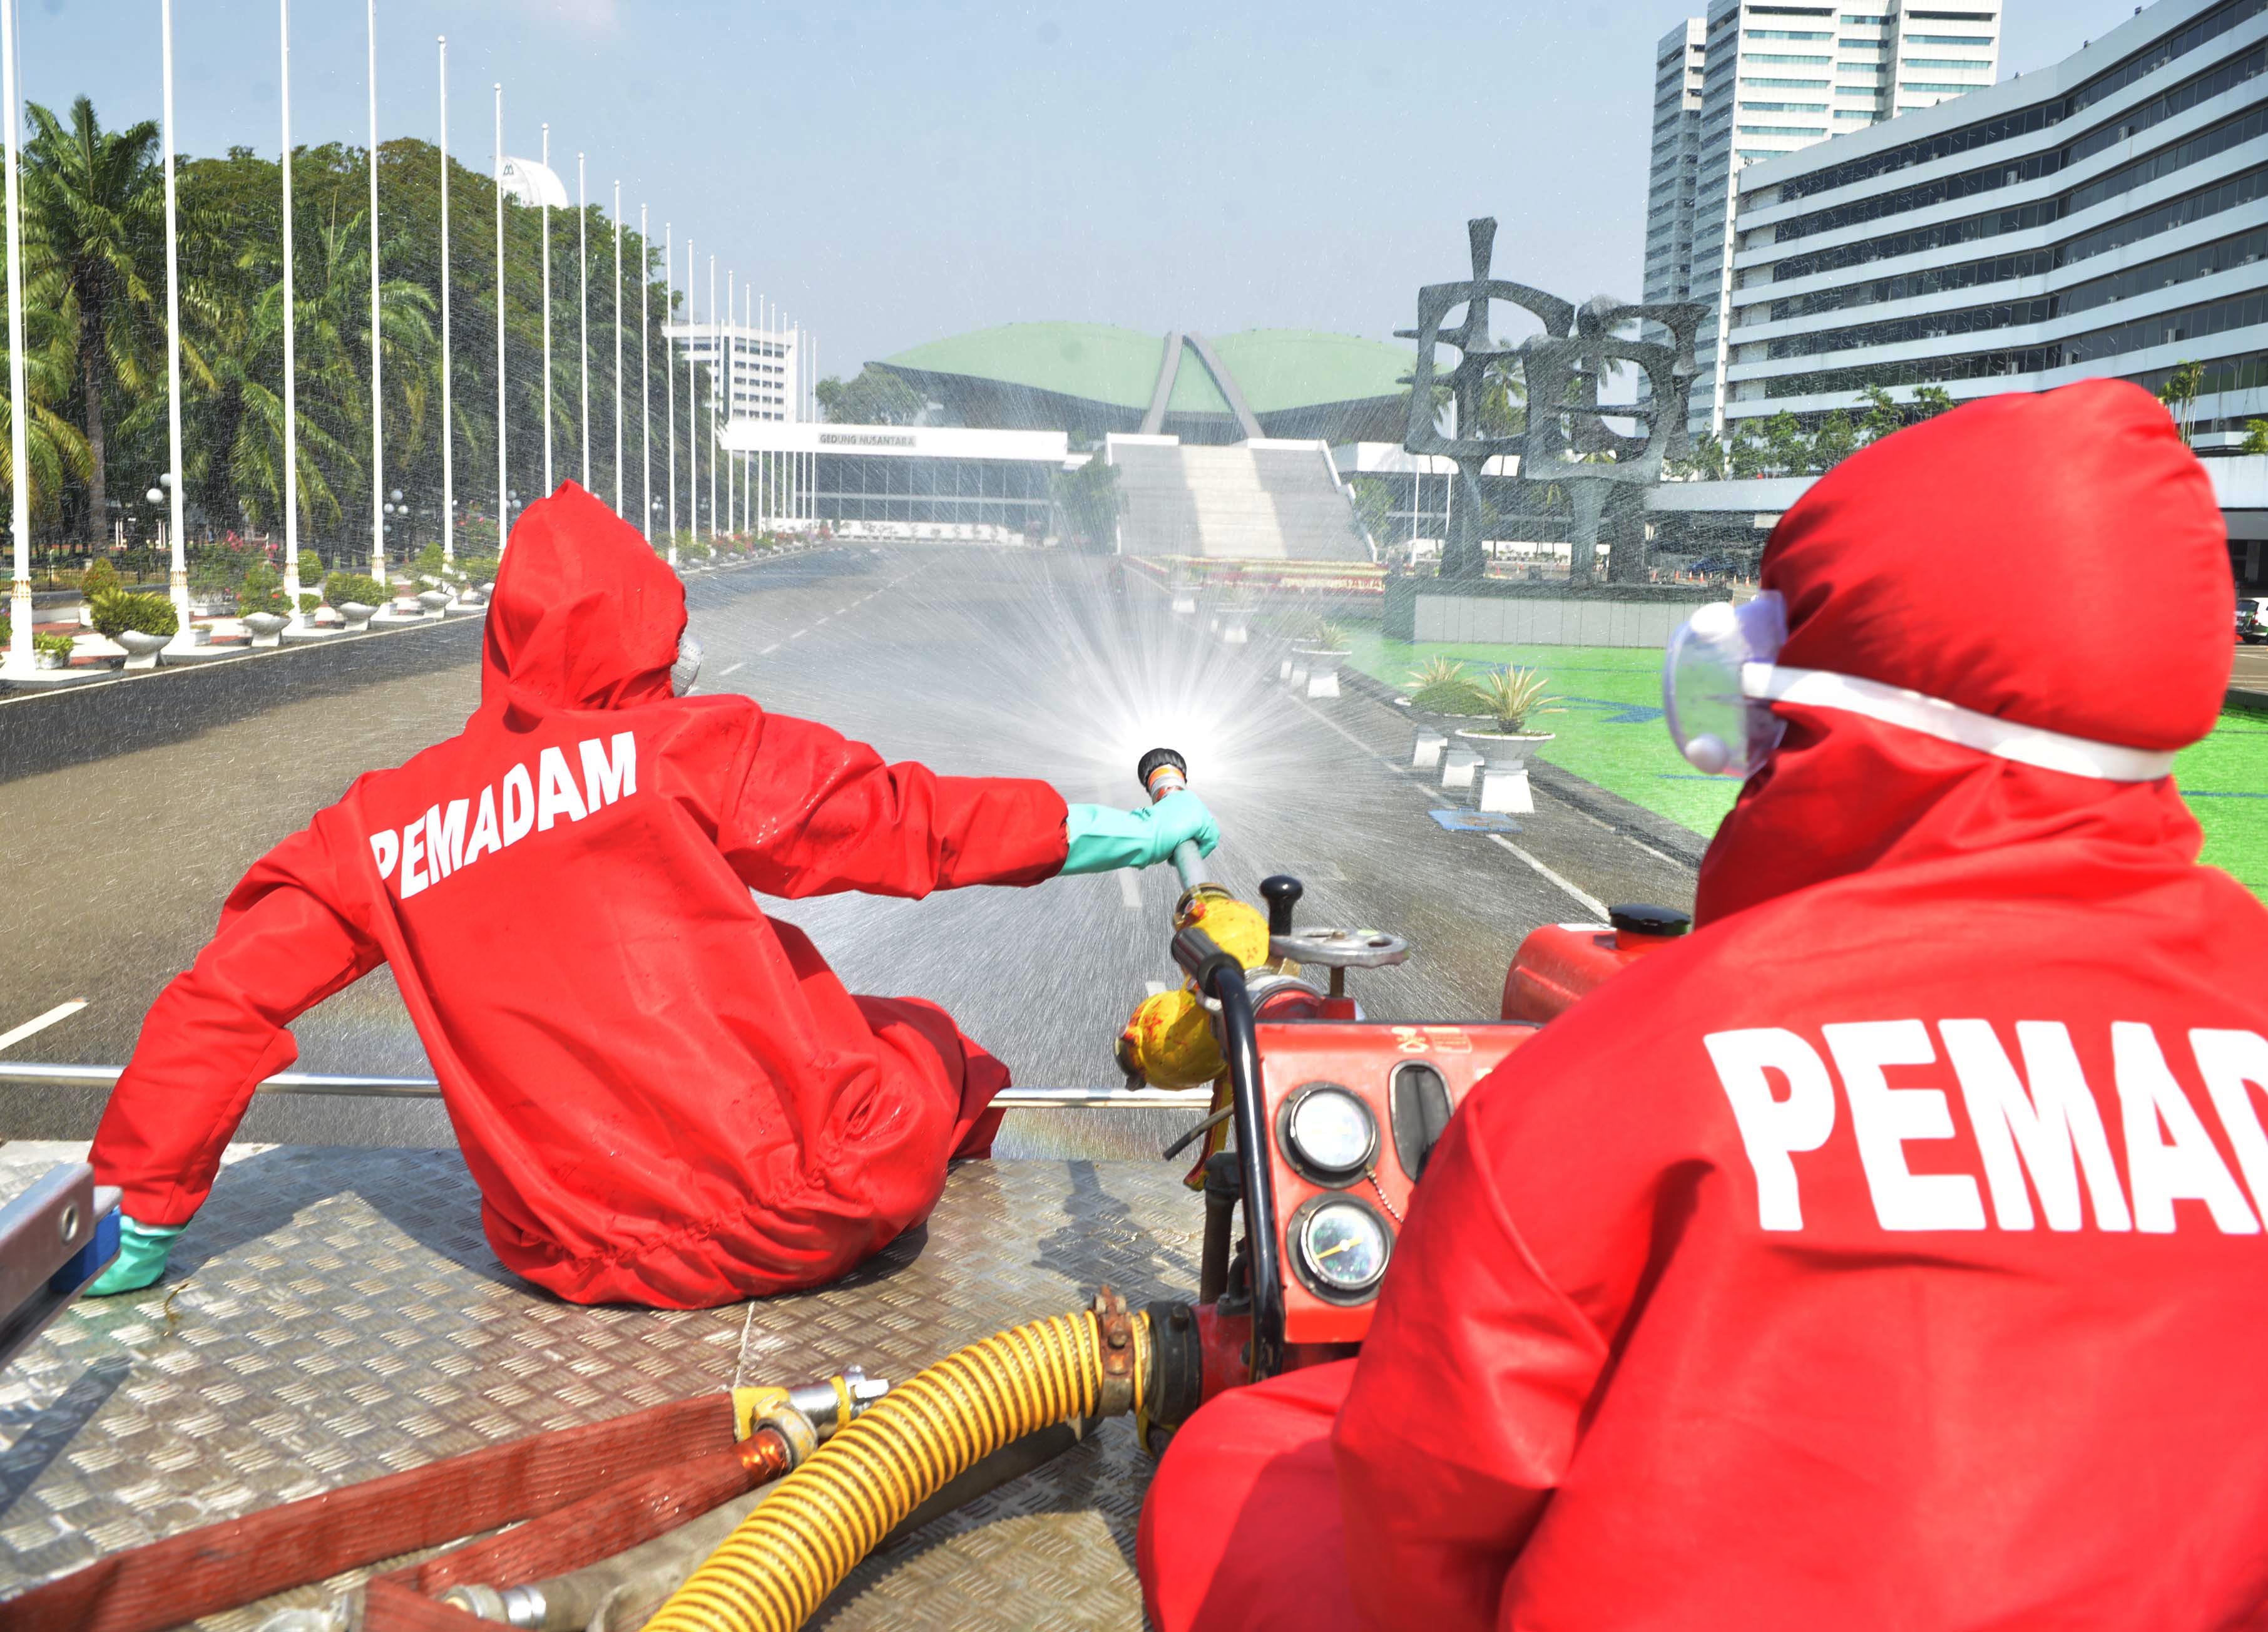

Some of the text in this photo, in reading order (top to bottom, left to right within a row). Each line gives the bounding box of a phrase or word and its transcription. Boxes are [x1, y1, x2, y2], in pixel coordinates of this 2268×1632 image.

[820, 434, 914, 446] GEDUNG NUSANTARA
[369, 731, 637, 900] PEMADAM
